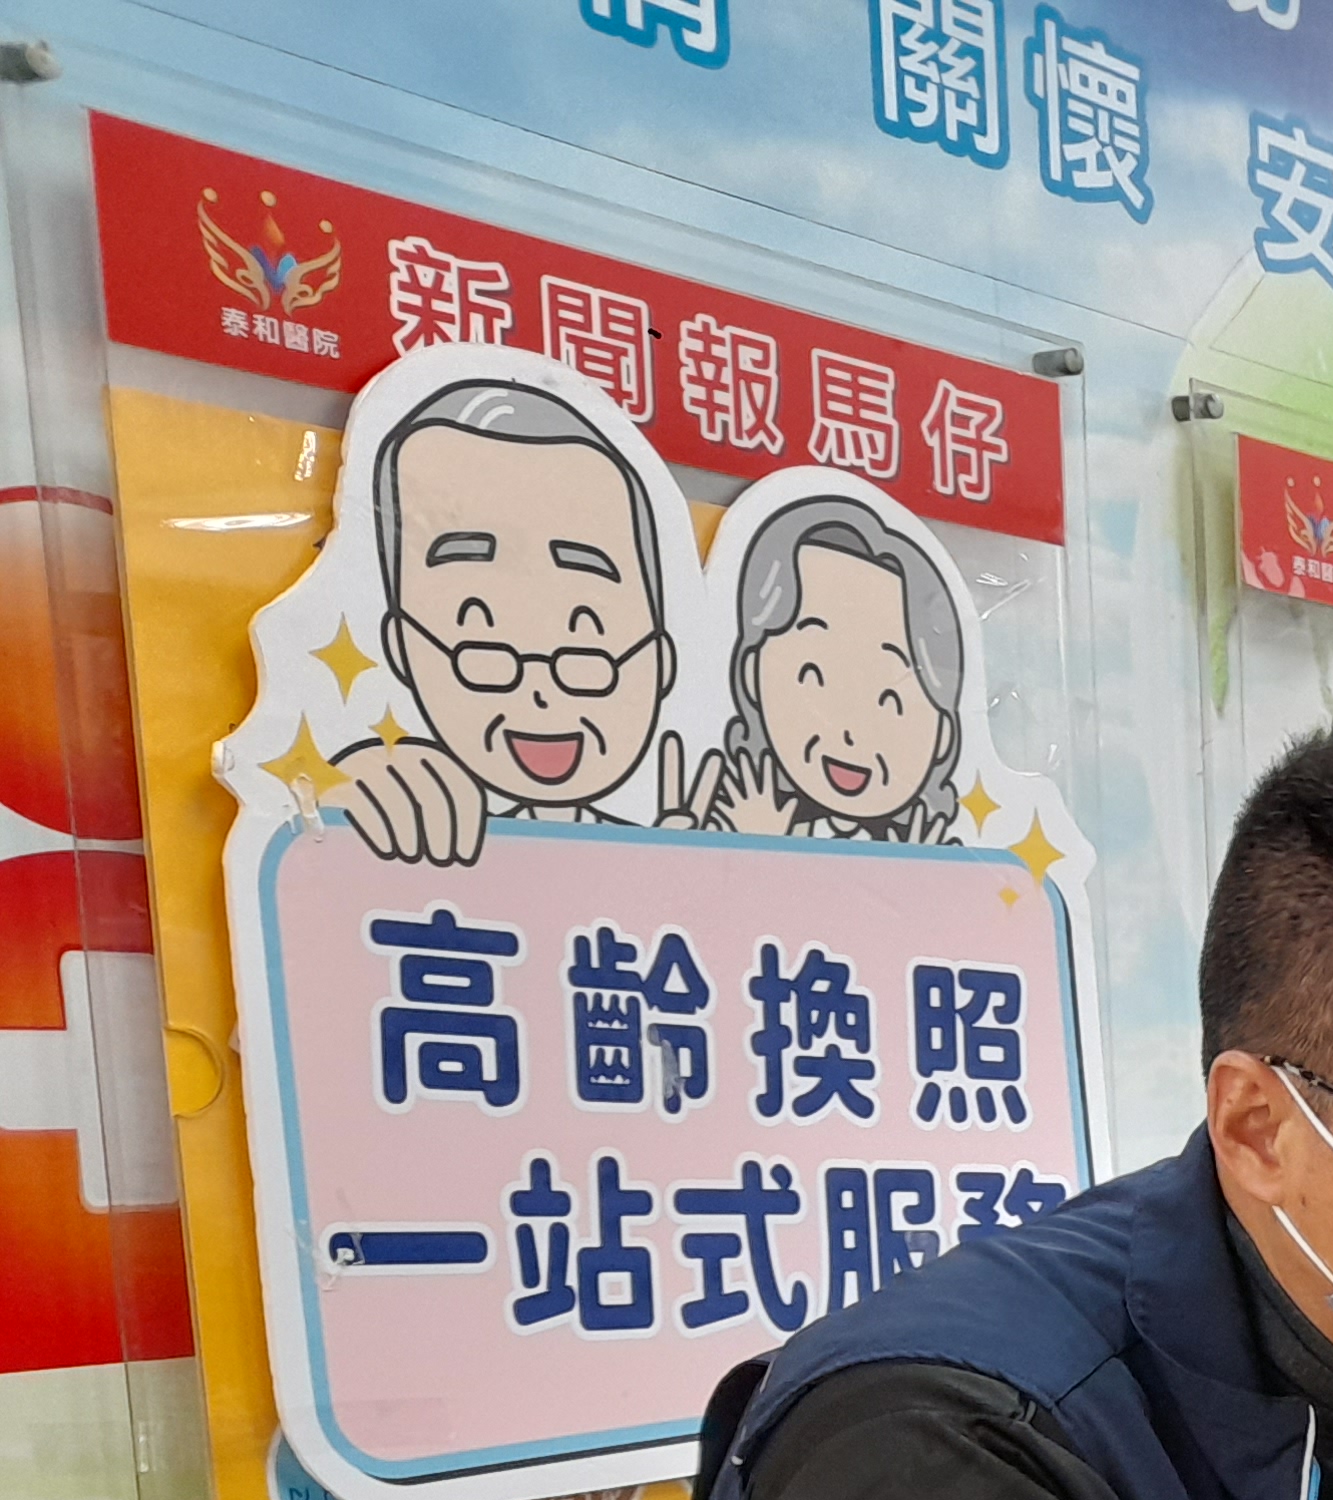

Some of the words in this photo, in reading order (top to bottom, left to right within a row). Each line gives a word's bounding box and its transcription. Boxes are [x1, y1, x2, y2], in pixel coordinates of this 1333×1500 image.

[221, 306, 342, 361] 泰和醫院
[388, 236, 1008, 505] 新聞報馬仔
[367, 906, 1030, 1126] 高齡換照
